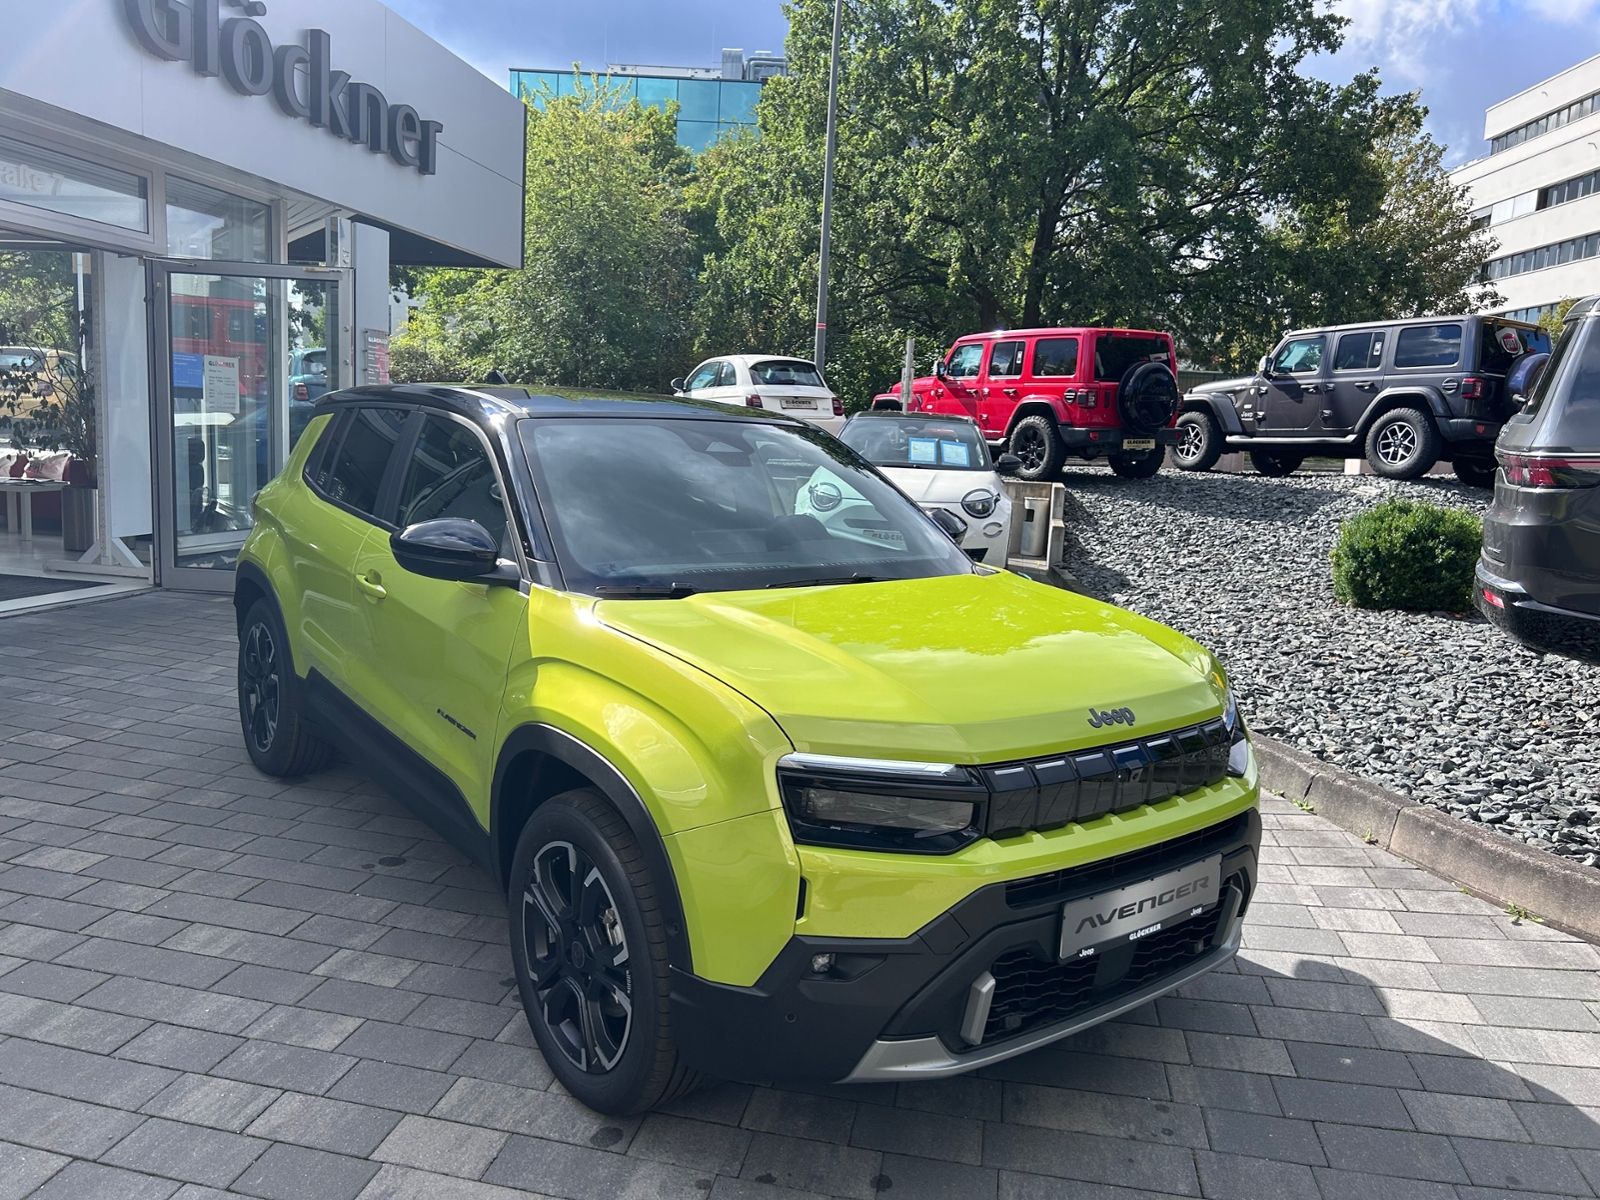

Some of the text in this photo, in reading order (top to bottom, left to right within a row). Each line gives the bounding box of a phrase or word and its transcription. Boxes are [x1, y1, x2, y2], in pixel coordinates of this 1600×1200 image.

[125, 0, 443, 175] Glöckner
[1087, 707, 1136, 729] Jeep
[1074, 875, 1210, 935] AVENGER
[1190, 906, 1203, 917] Jeep
[1128, 923, 1162, 941] GLÖCKNER
[1078, 947, 1095, 958] Jeep
